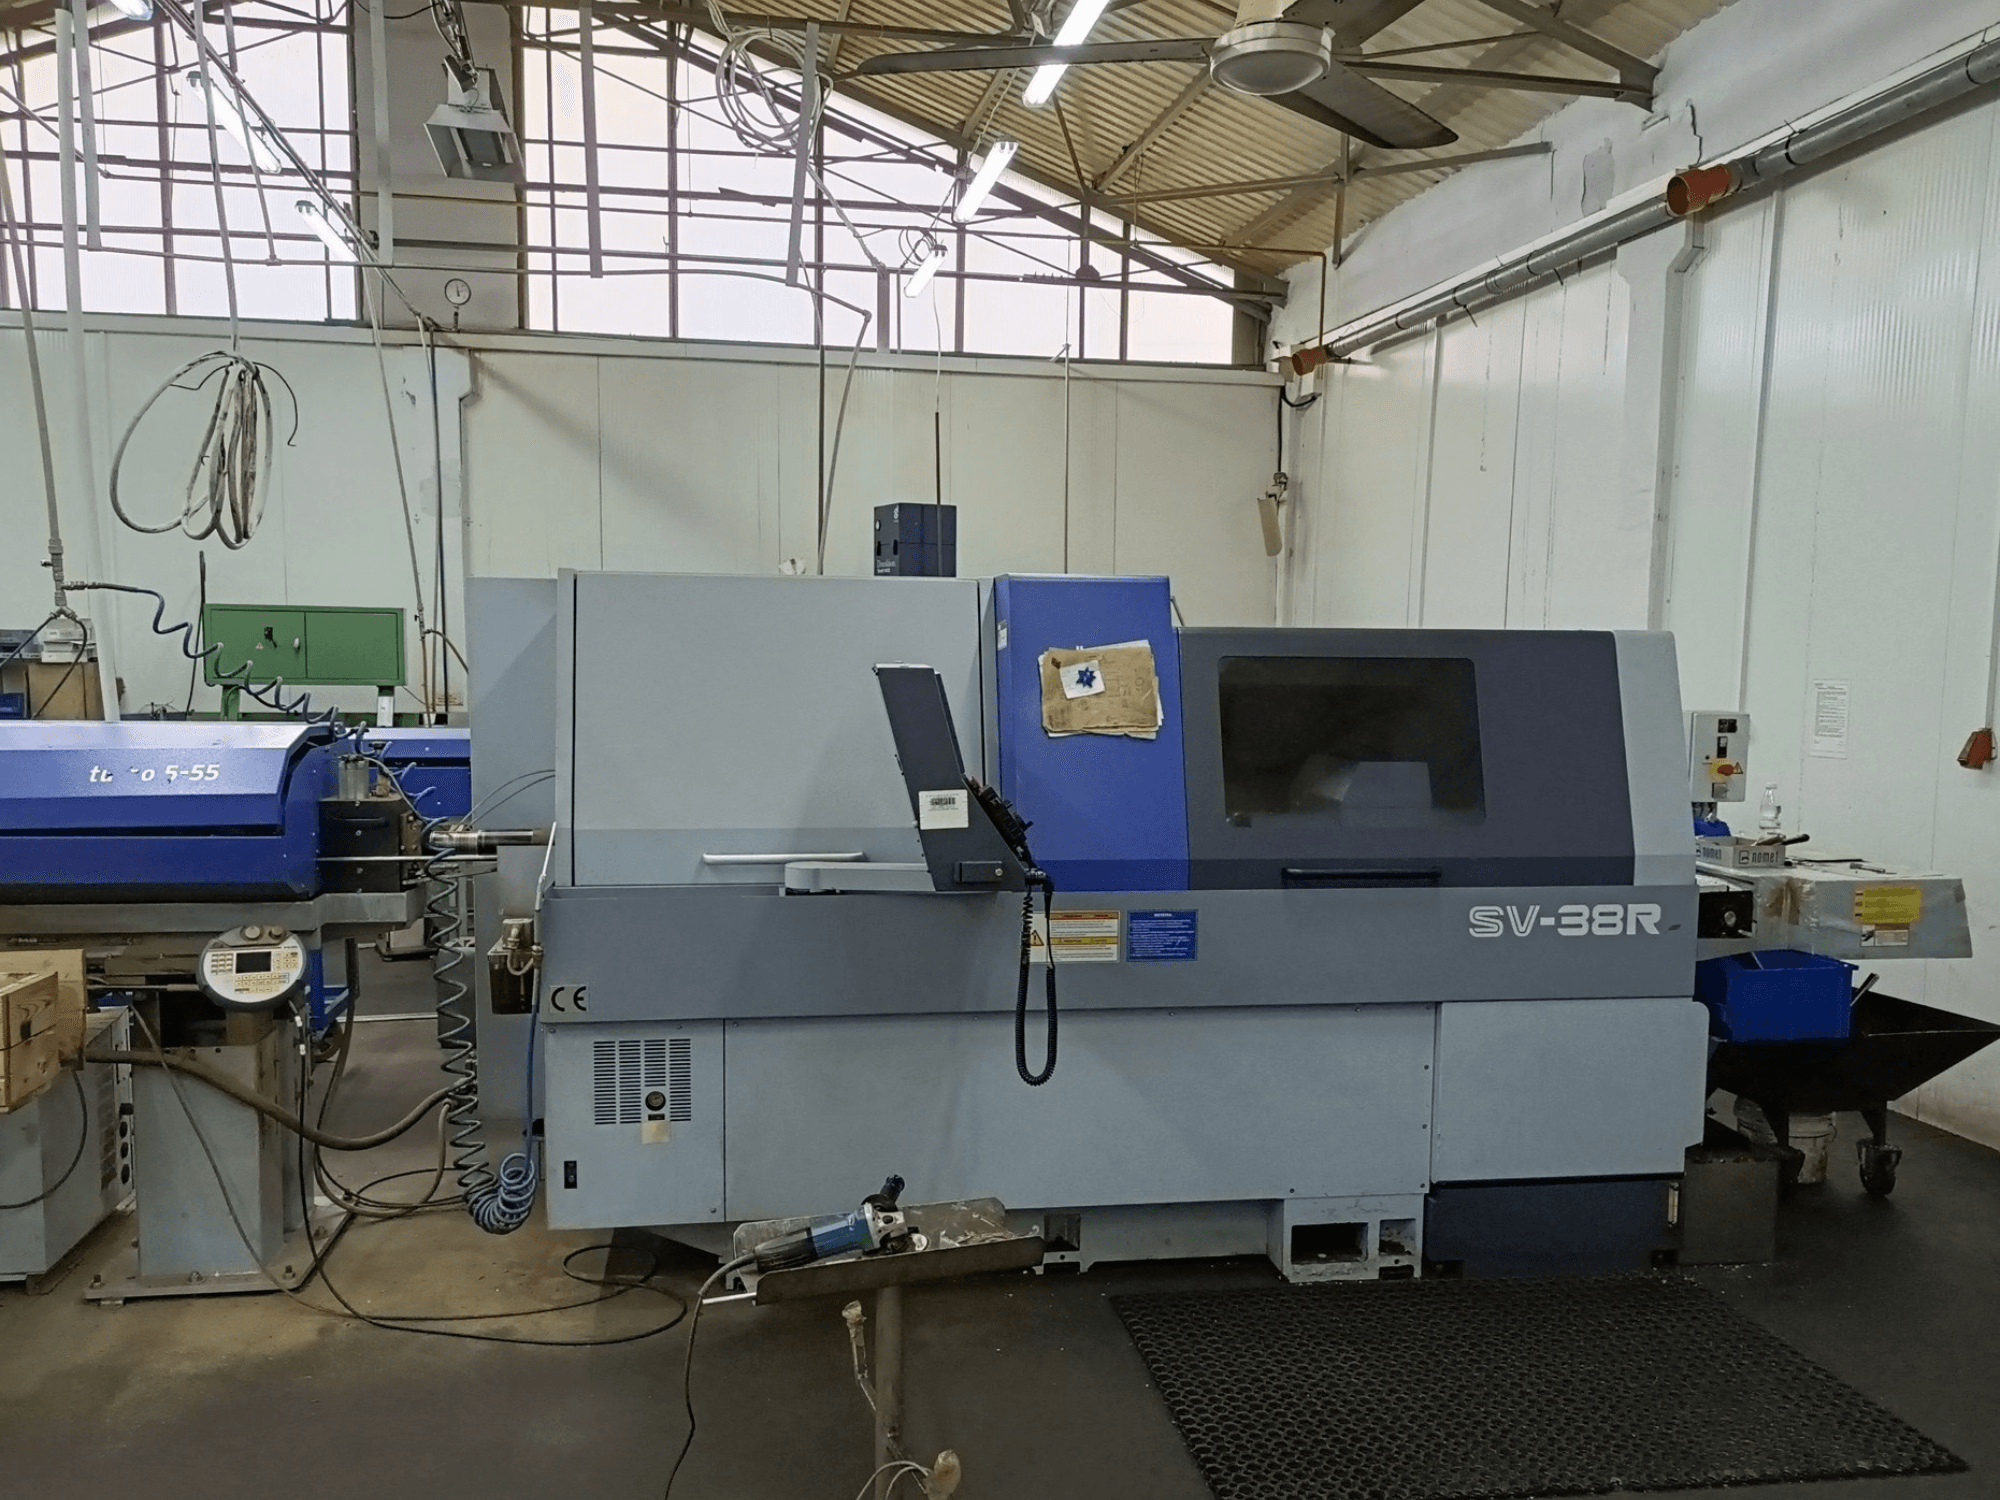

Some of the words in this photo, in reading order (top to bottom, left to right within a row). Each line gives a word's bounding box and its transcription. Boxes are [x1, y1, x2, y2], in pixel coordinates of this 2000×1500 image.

[165, 763, 220, 782] 5-55
[1468, 903, 1662, 938] SV-38R
[551, 986, 587, 1012] CE
